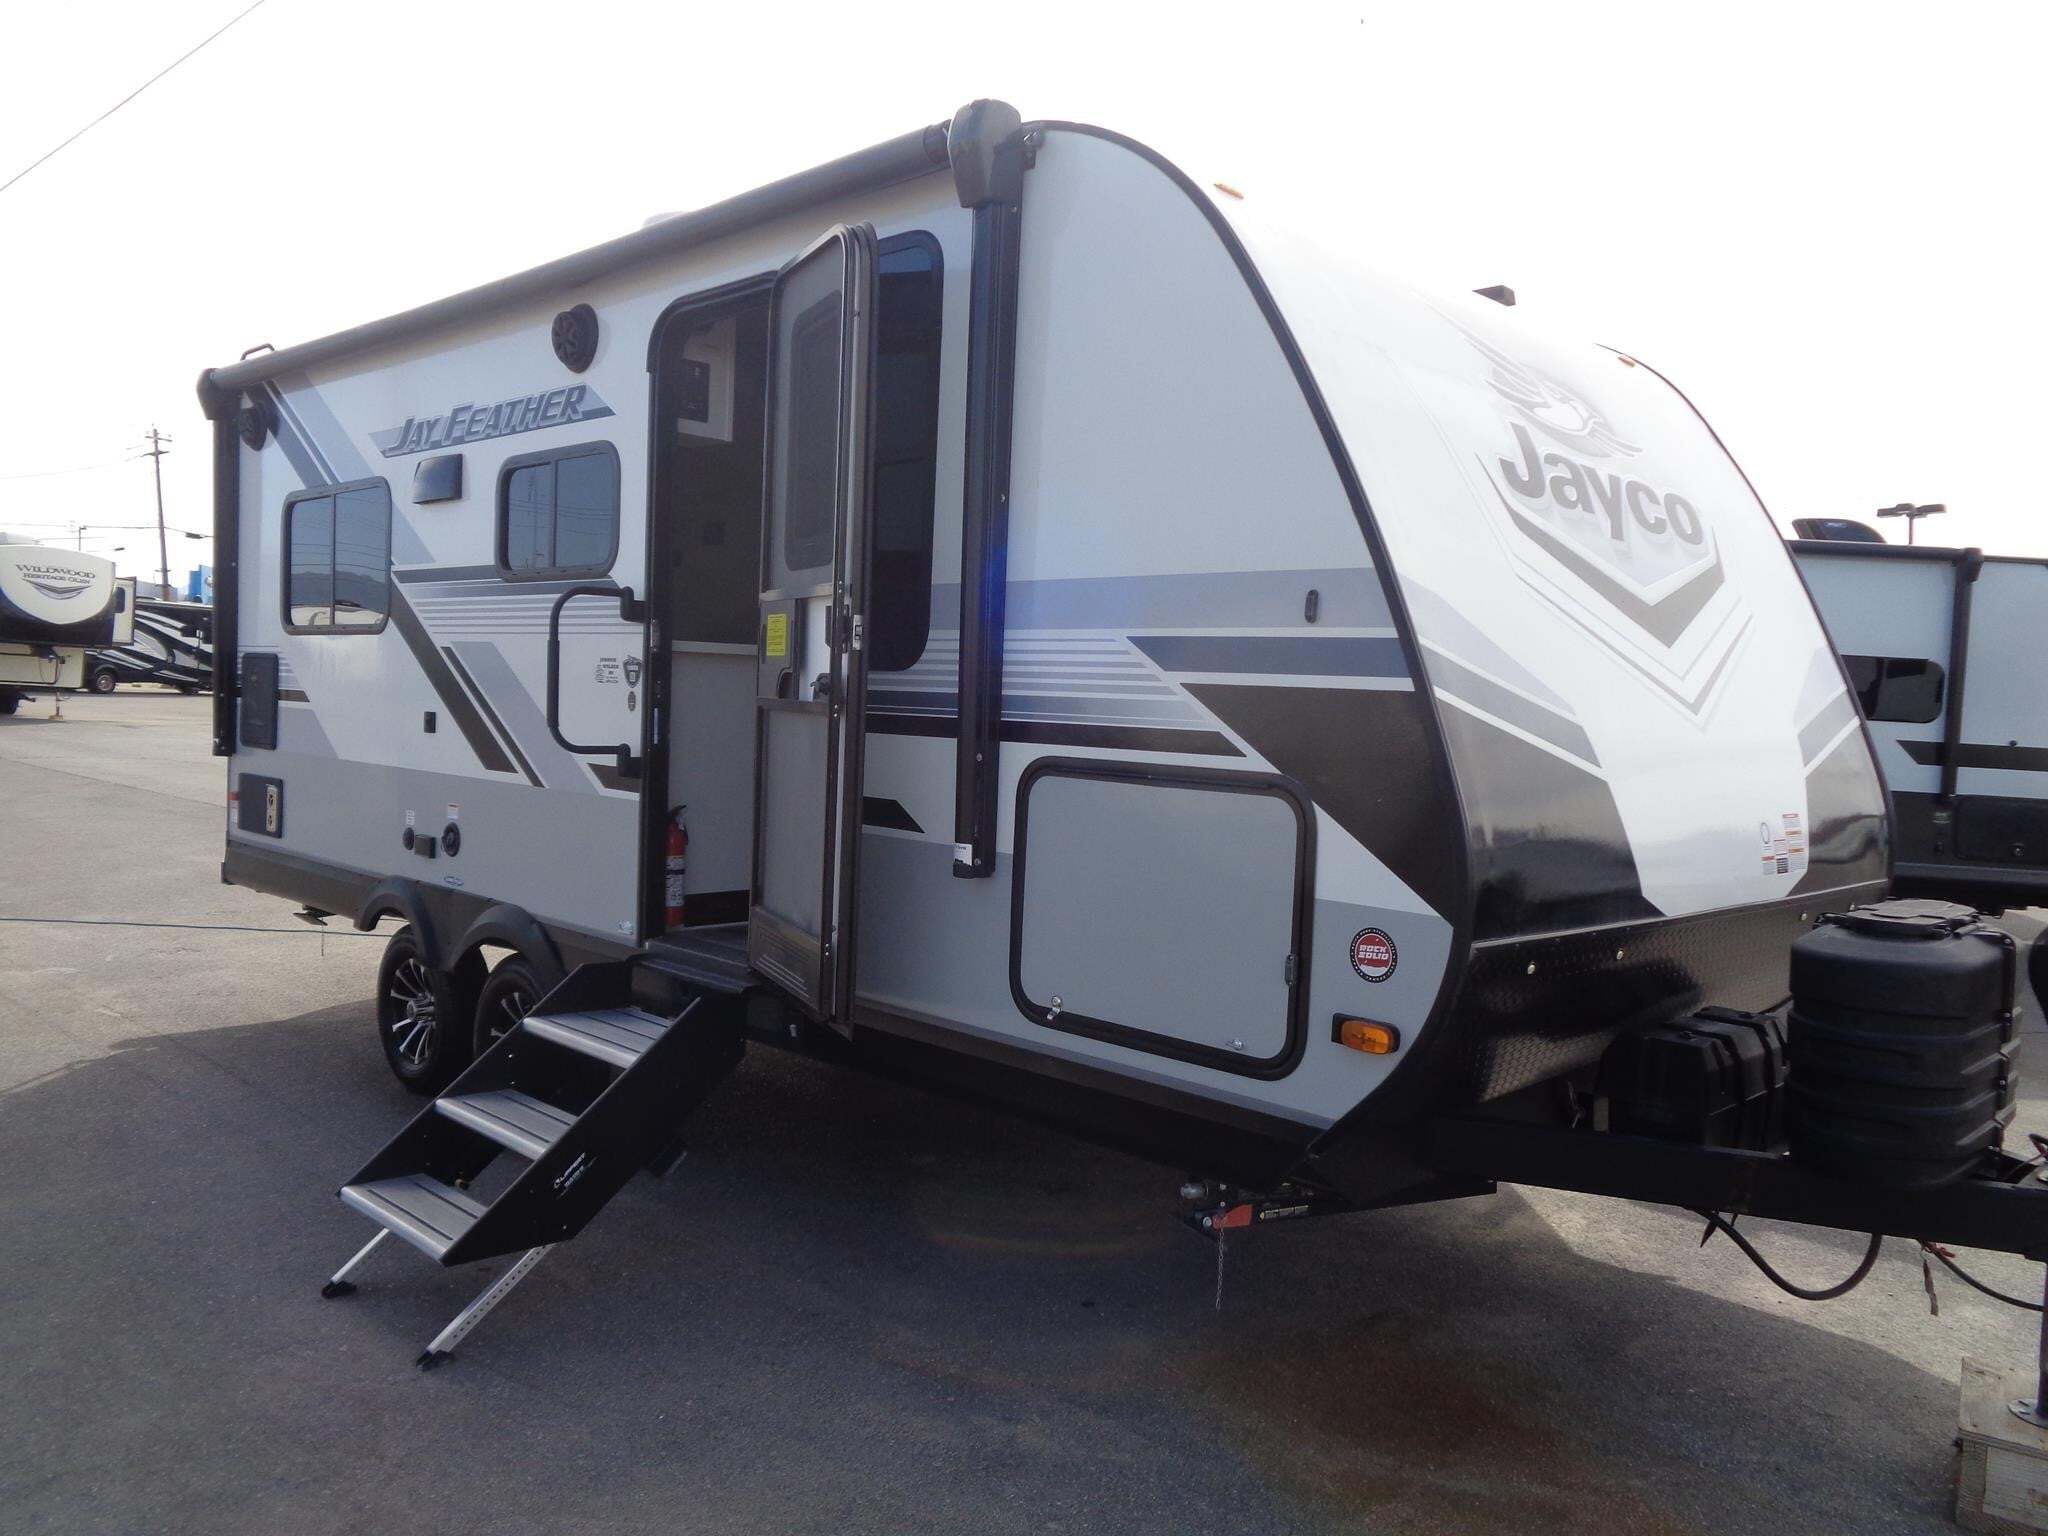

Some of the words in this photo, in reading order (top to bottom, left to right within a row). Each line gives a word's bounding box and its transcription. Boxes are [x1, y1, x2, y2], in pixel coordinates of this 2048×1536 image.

[386, 416, 441, 451] JAY
[442, 382, 587, 446] FEATHER
[1498, 421, 1703, 546] Jayco
[16, 564, 95, 579] WILDWOOD
[1358, 951, 1389, 960] SOLID
[1359, 944, 1387, 953] ROCK
